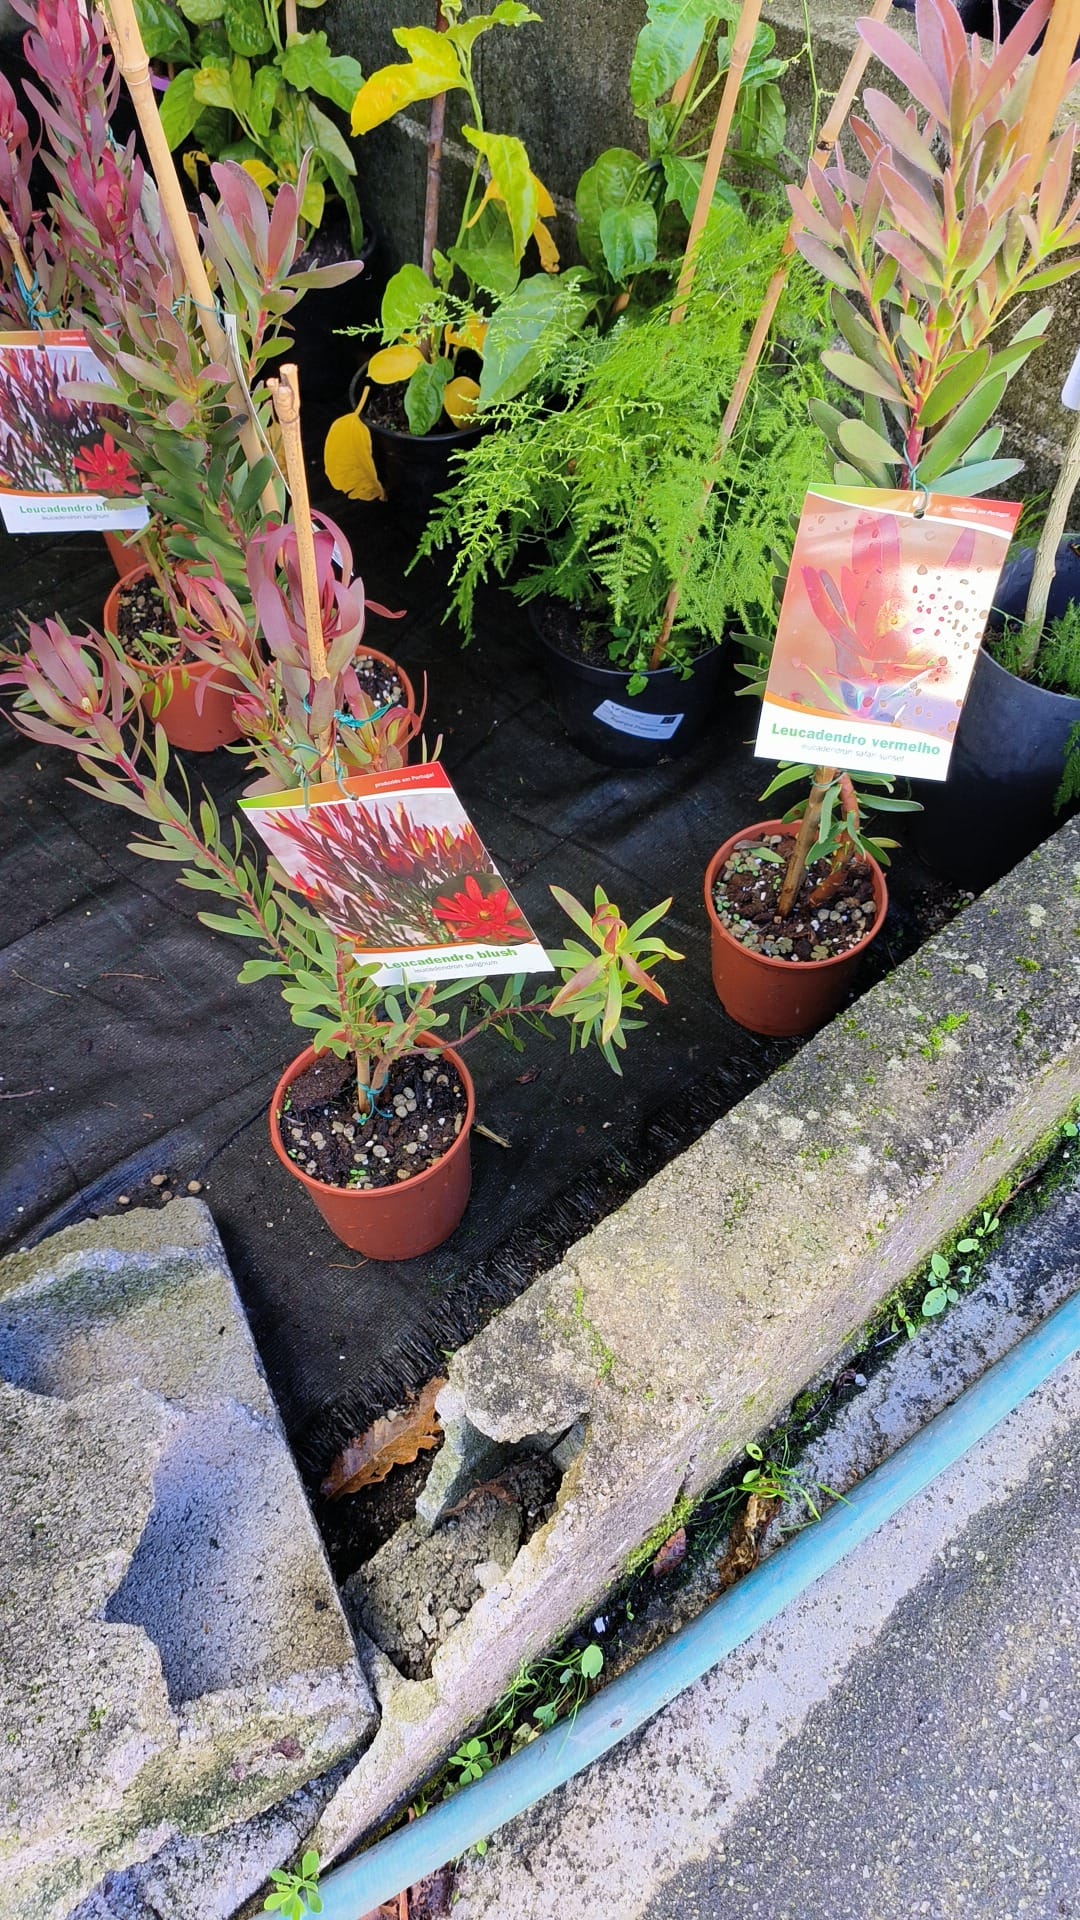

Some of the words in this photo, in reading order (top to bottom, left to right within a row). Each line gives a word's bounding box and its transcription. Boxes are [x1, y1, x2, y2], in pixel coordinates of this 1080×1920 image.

[19, 503, 93, 514] Leucadendro
[771, 723, 867, 746] Leucadendro
[872, 737, 941, 756] vermelho
[383, 953, 474, 970] Leucadendro
[477, 948, 518, 959] blush
